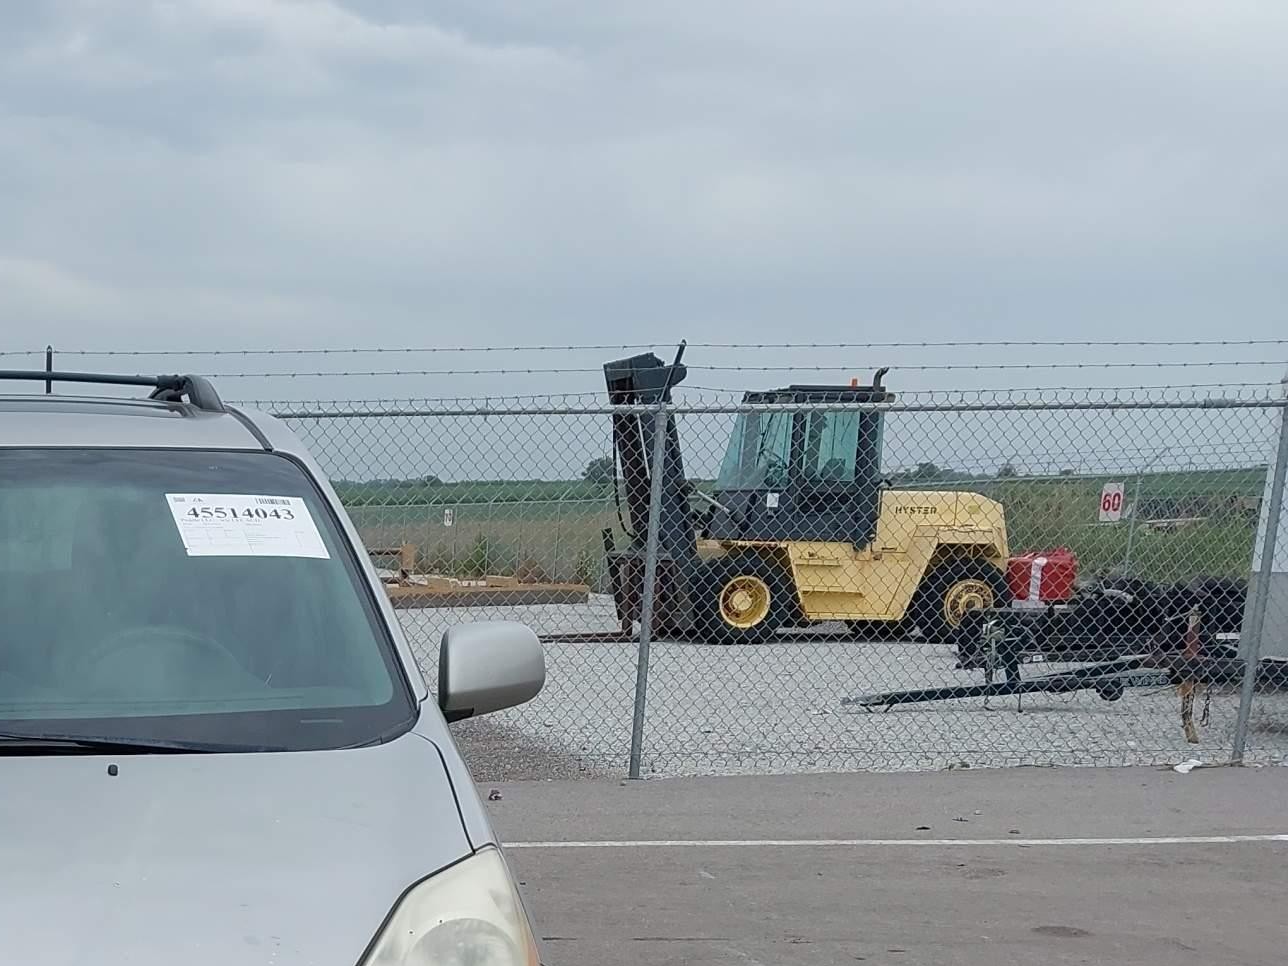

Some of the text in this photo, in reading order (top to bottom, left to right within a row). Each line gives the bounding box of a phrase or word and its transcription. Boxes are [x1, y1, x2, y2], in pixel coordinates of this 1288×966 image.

[1102, 492, 1121, 512] 60
[187, 506, 295, 521] 45514043
[895, 506, 937, 515] HYSTER
